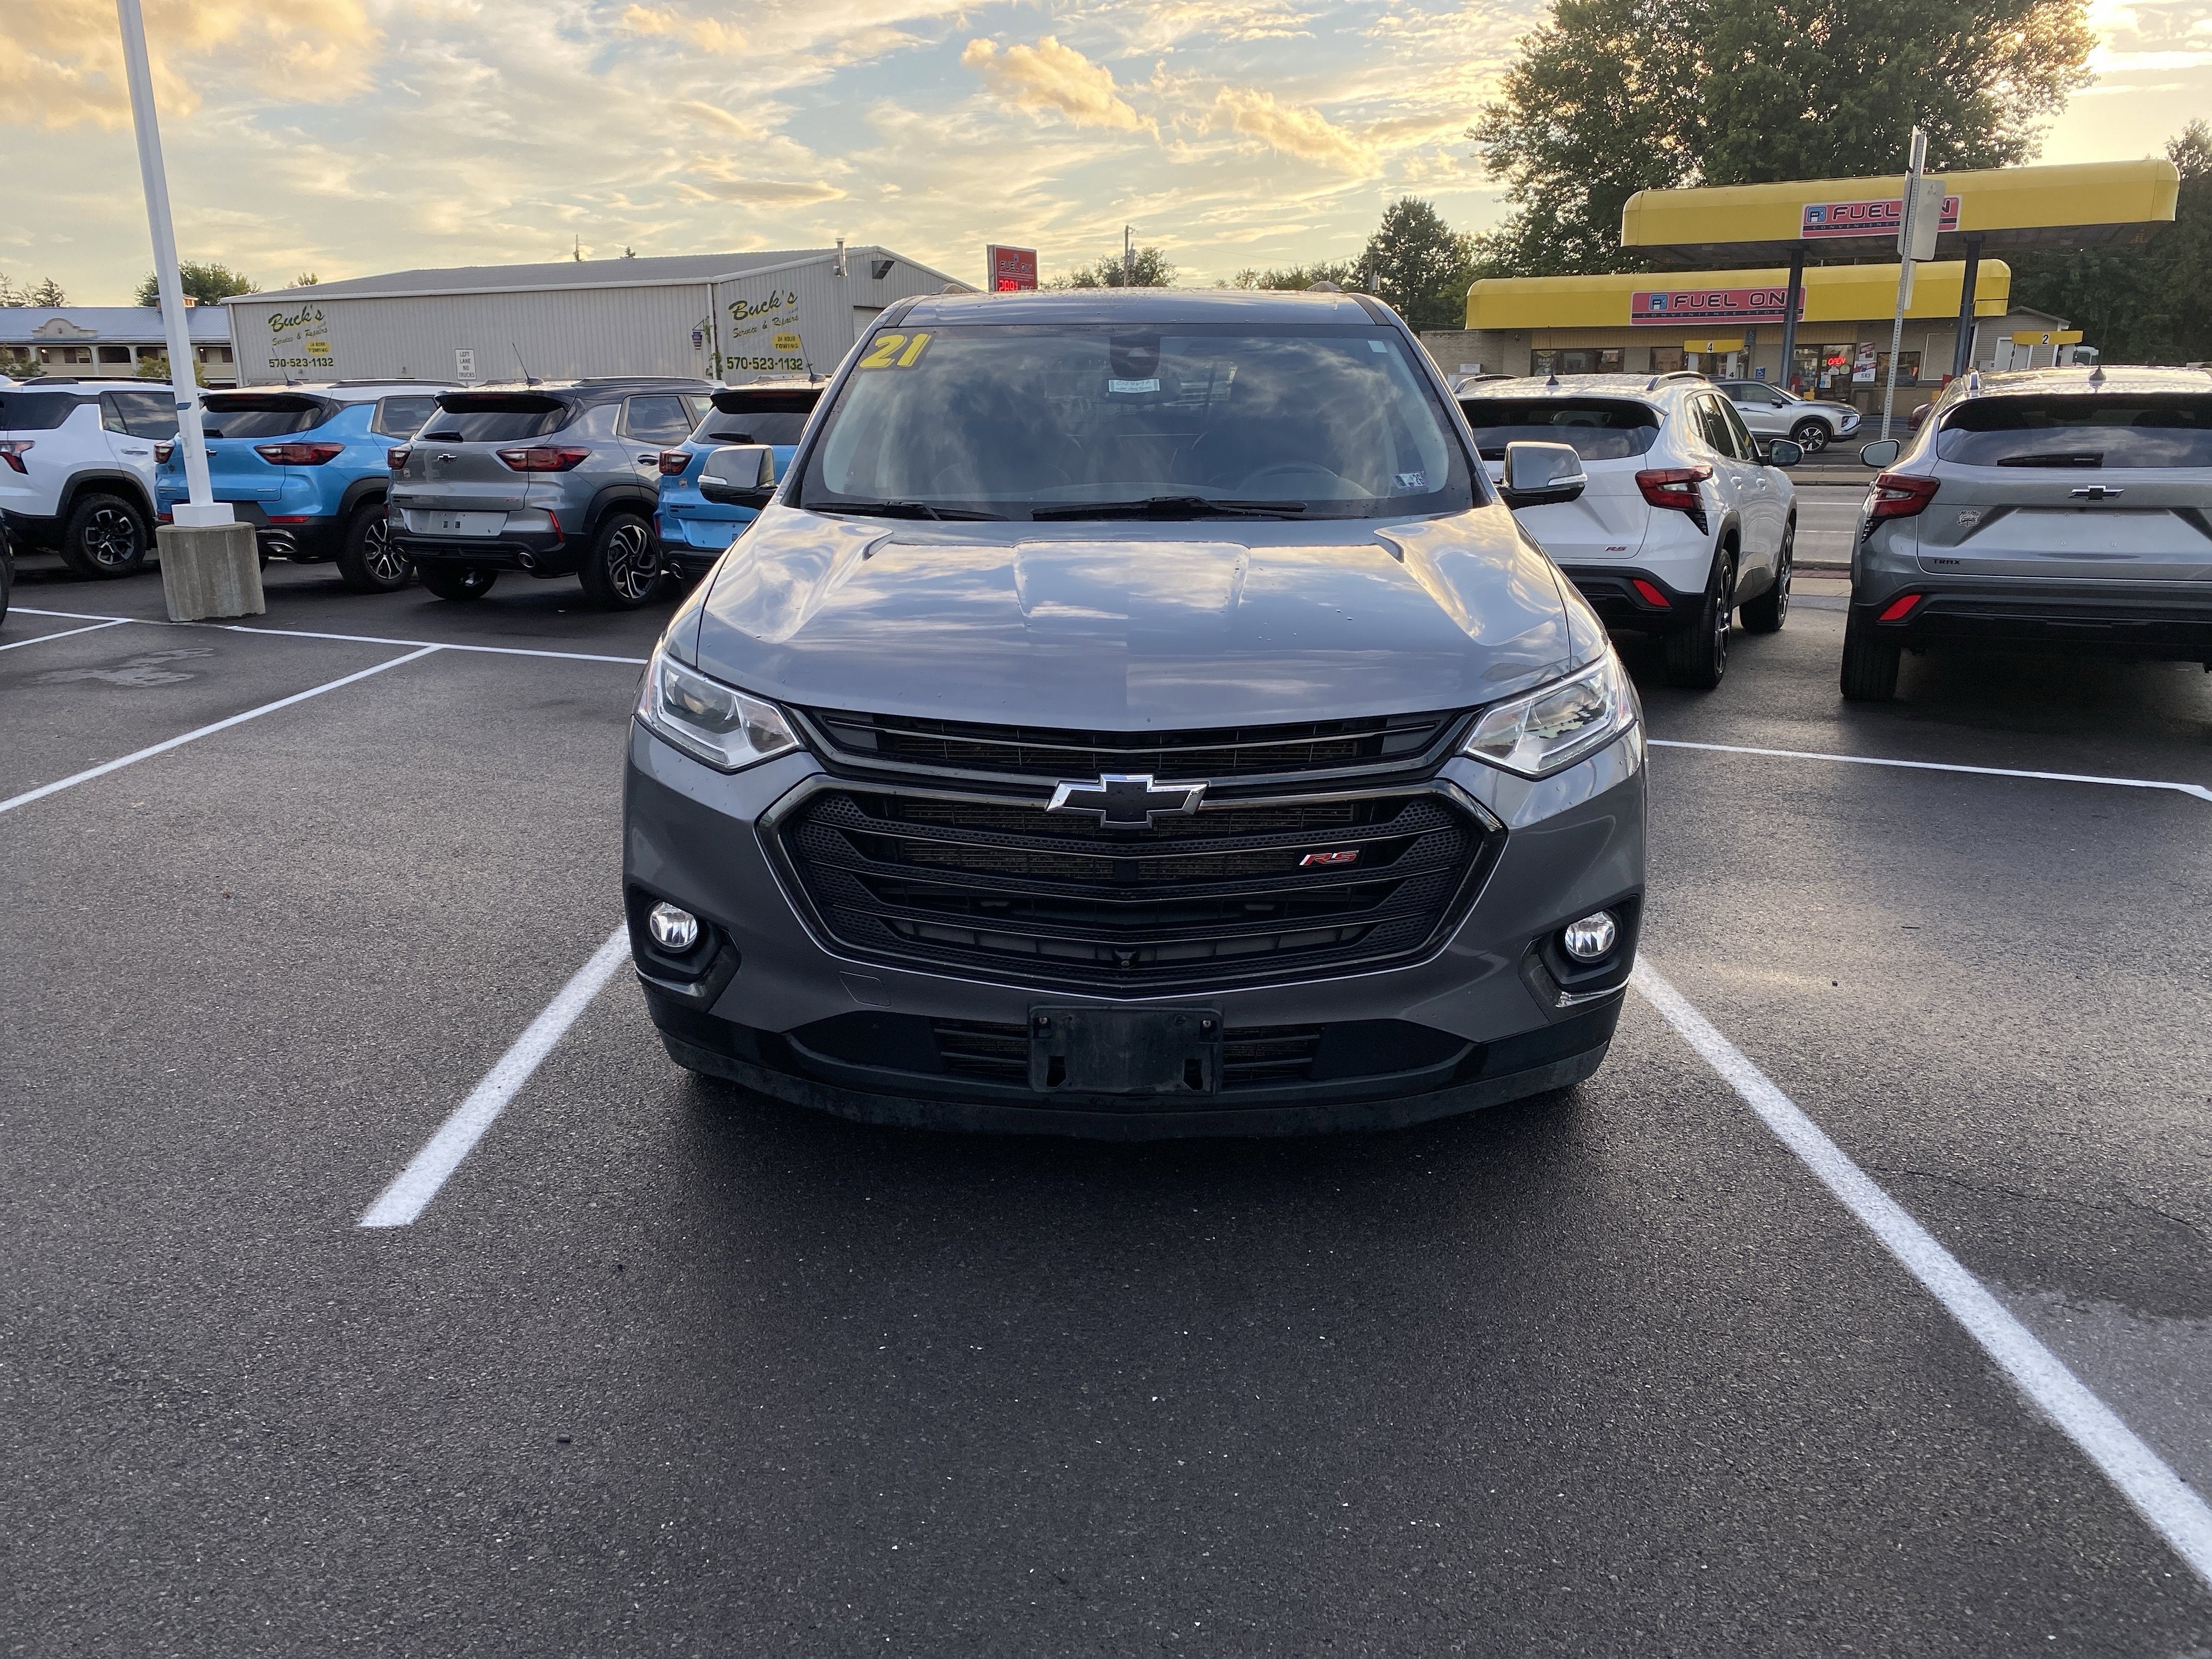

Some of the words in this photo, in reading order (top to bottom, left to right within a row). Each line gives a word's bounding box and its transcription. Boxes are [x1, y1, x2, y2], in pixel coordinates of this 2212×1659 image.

[1832, 203, 1901, 221] FUEL
[1000, 261, 1019, 272] FUEL
[1021, 263, 1032, 273] ON
[729, 290, 798, 320] Buck's
[1673, 294, 1738, 309] FUEL
[1749, 291, 1786, 307] ON
[268, 304, 325, 332] Buck's
[762, 320, 768, 329] &
[772, 315, 799, 327] Repairs
[2042, 334, 2049, 345] 2
[859, 333, 932, 369] 21
[1708, 343, 1713, 352] 4
[268, 358, 334, 368] 570-523-1132
[726, 357, 803, 370] 570-523-1132
[1827, 357, 1846, 366] OPEN
[1299, 850, 1359, 866] RS
